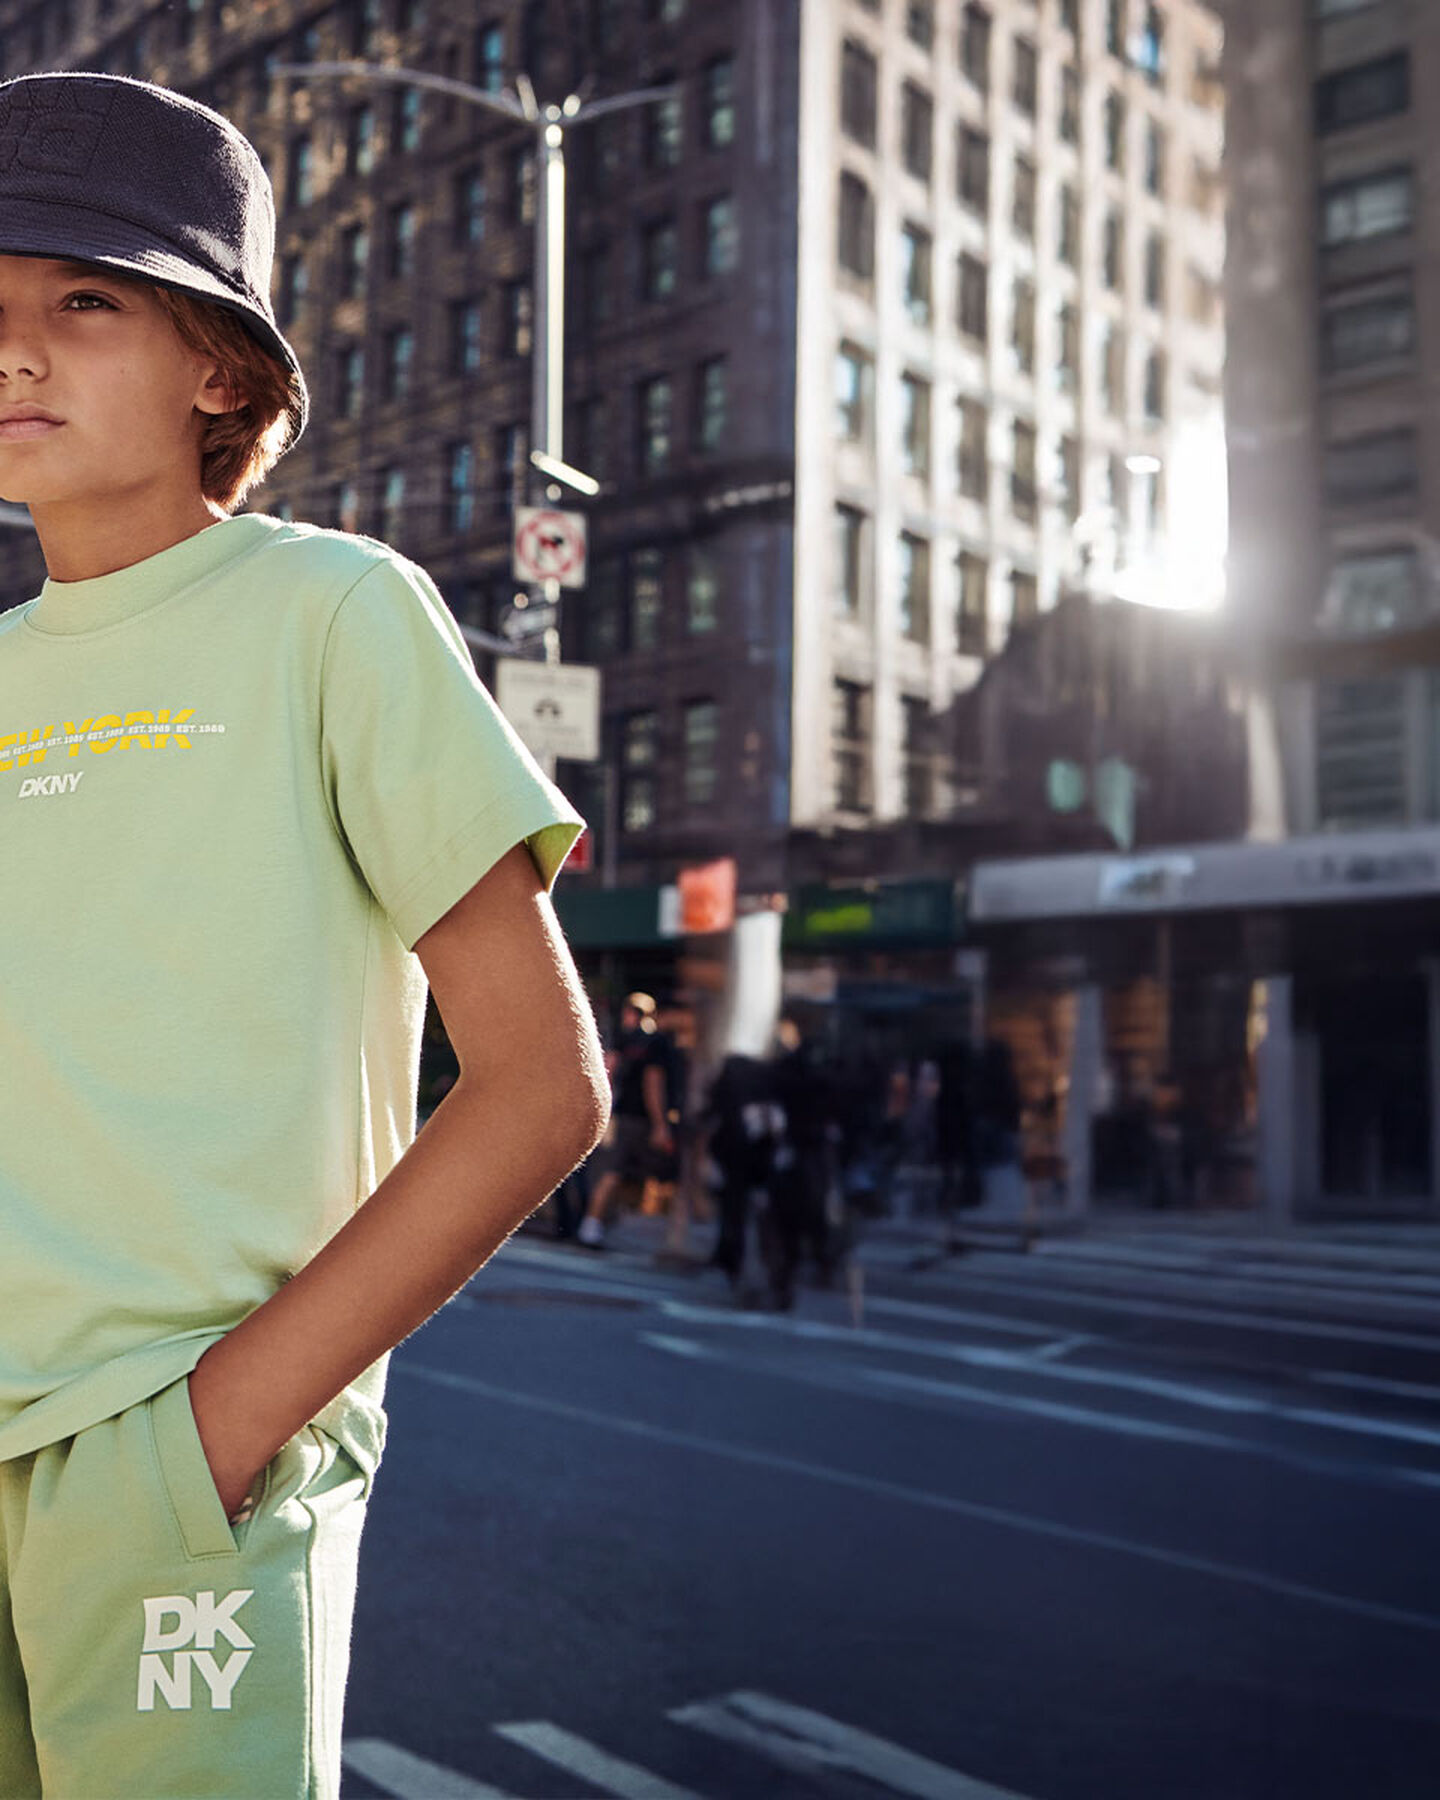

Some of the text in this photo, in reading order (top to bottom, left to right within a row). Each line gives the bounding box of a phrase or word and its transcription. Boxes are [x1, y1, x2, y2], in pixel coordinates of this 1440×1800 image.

[63, 708, 196, 757] YORK
[18, 772, 83, 798] DKNY
[142, 1589, 256, 1652] DK
[137, 1650, 253, 1711] NY
